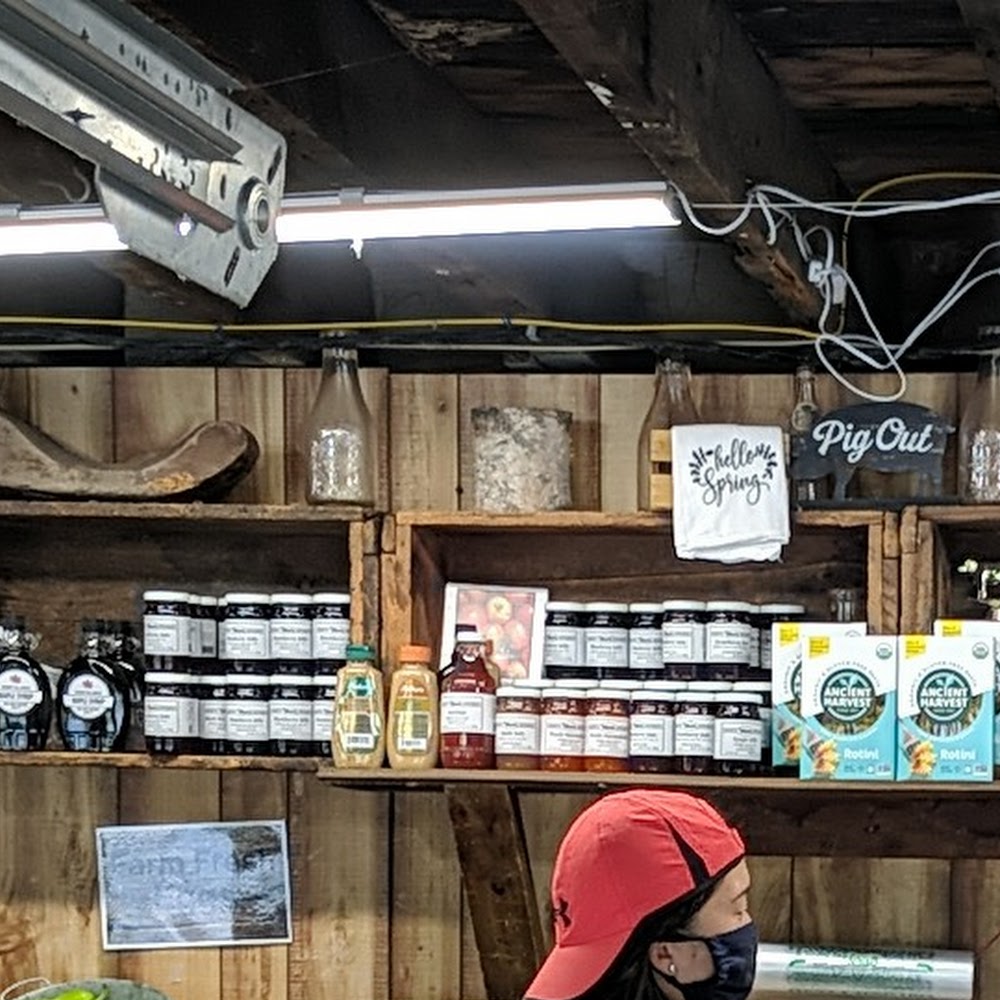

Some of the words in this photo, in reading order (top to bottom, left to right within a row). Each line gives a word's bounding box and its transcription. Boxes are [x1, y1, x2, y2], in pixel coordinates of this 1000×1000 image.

[812, 419, 874, 463] Pig
[875, 417, 934, 452] Out
[713, 438, 757, 472] hello
[700, 467, 770, 507] Spring
[824, 687, 873, 698] ANCIENT
[920, 687, 968, 698] ANCIENT
[824, 697, 873, 708] HARVEST
[920, 697, 968, 708] HARVEST
[844, 748, 880, 760] Rotini
[940, 748, 976, 760] Rotini
